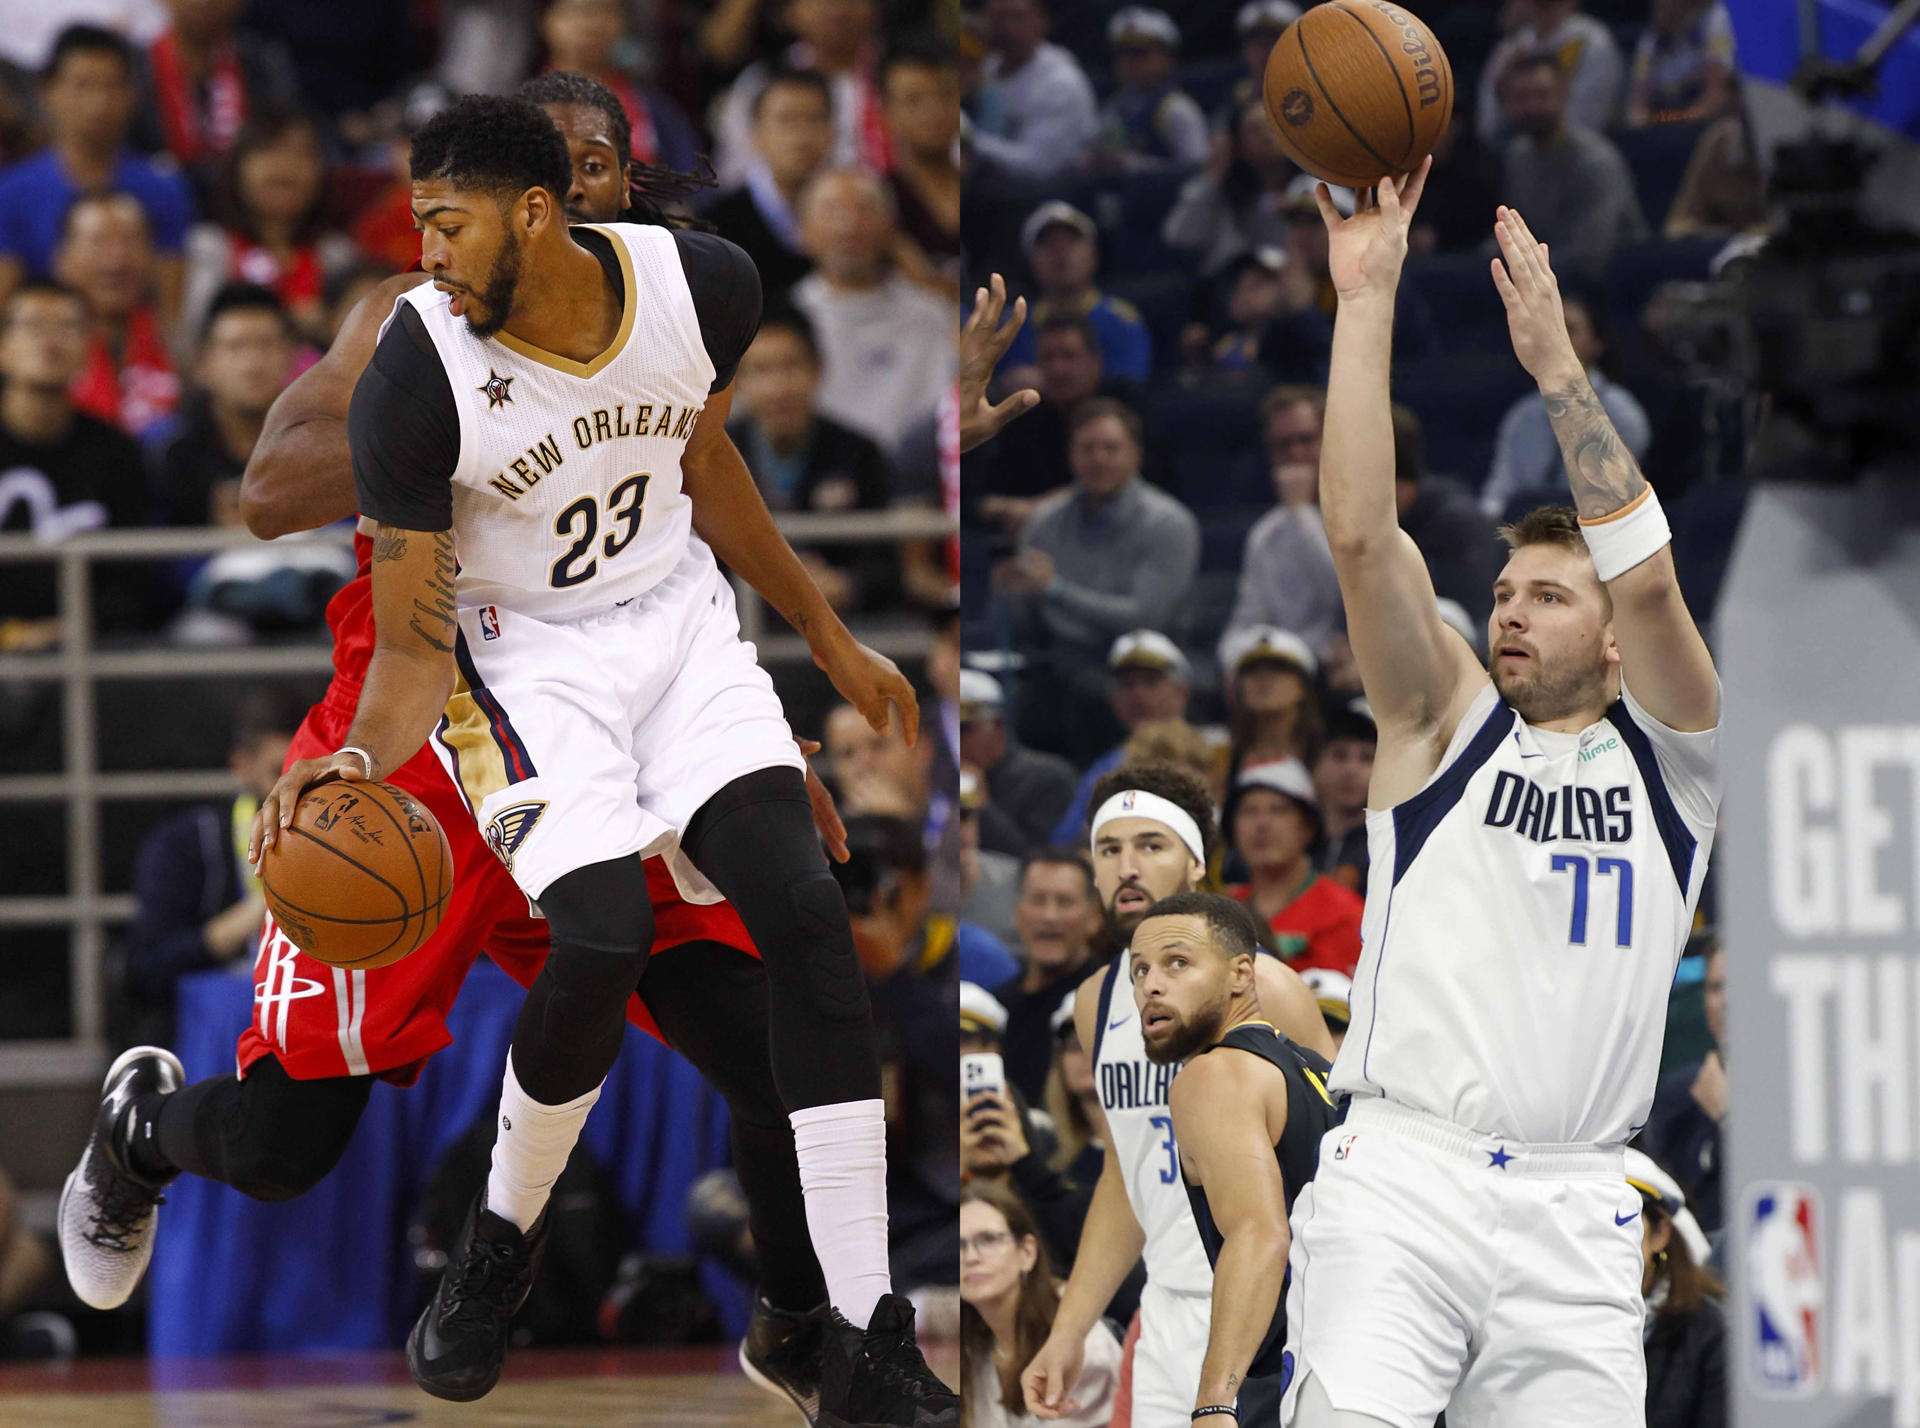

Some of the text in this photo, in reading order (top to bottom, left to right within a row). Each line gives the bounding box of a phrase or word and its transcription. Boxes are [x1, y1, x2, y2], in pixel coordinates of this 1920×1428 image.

[488, 404, 700, 501] NEW ORLEANS
[549, 471, 652, 590] 23
[1483, 769, 1634, 845] DALLAS
[1550, 852, 1634, 949] 77
[1768, 953, 1920, 1166] TH
